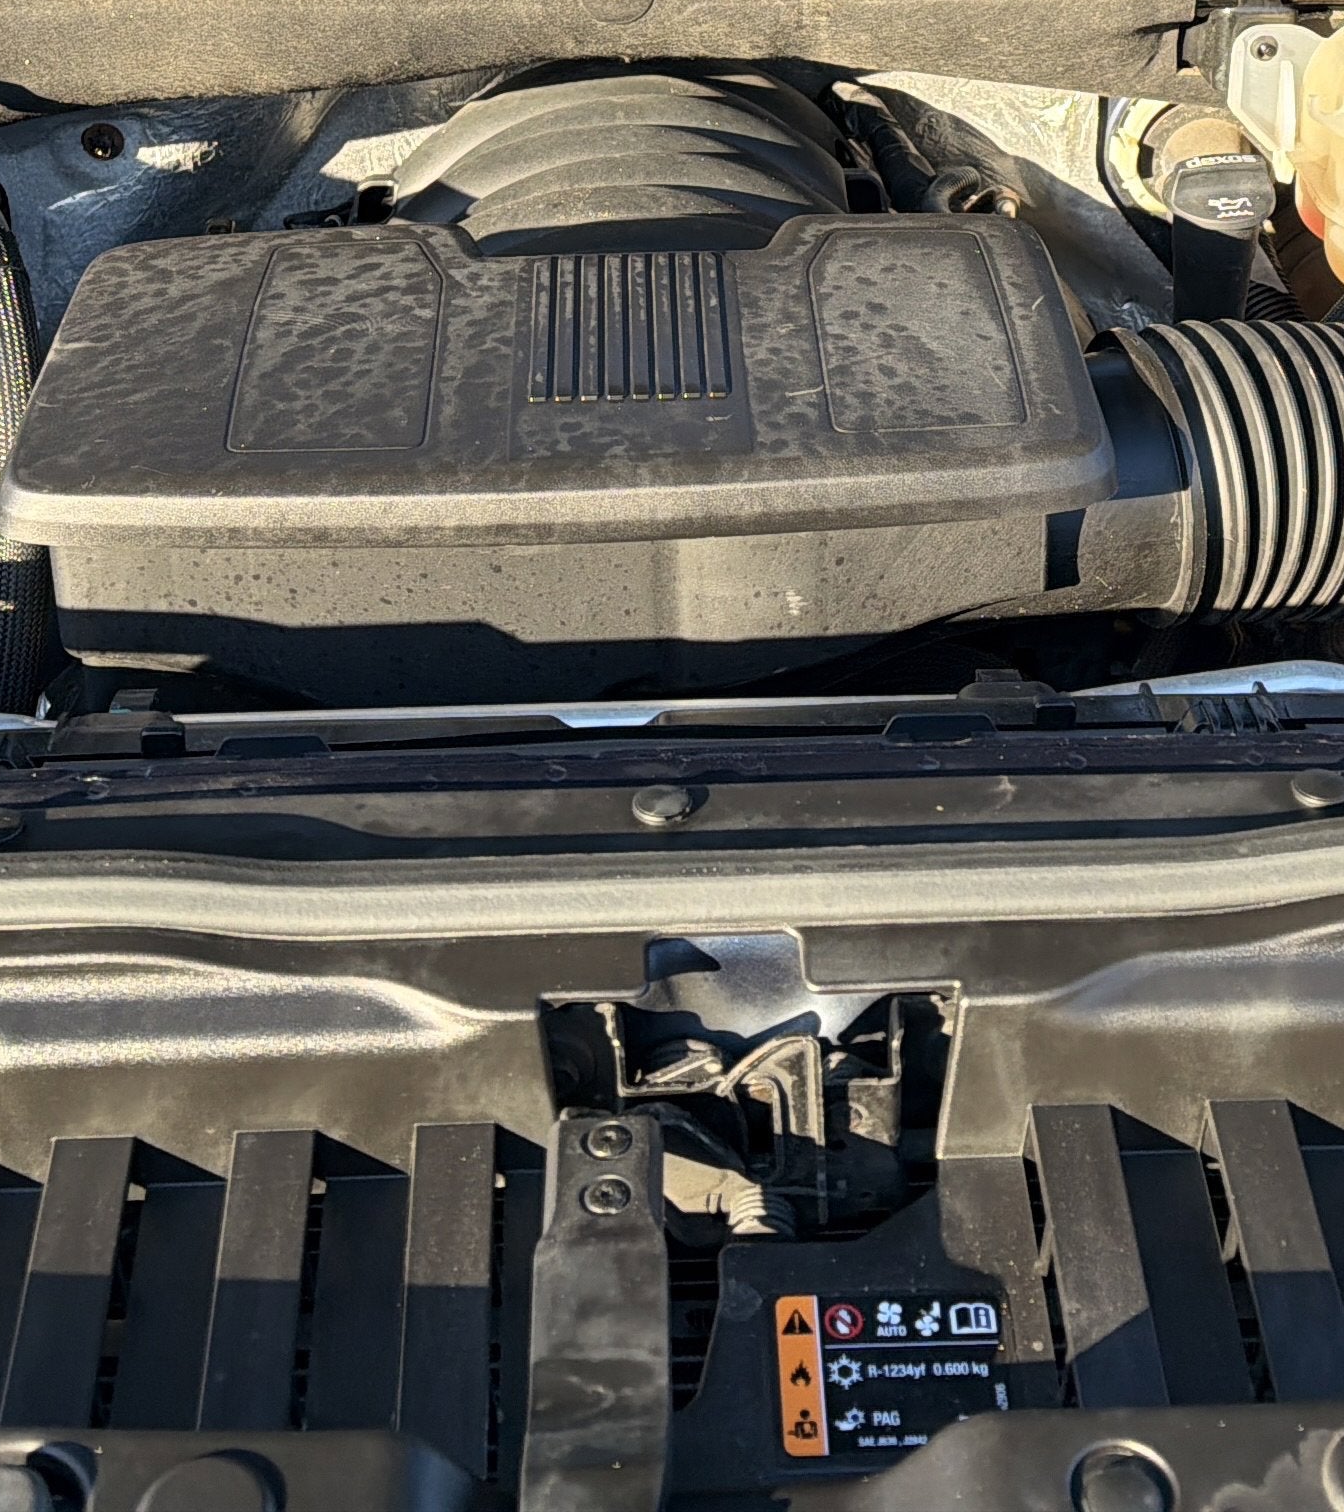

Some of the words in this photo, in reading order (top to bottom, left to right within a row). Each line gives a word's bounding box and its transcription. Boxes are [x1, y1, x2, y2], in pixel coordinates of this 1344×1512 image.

[1185, 154, 1257, 169] dexos
[877, 1325, 907, 1337] AUTO
[868, 1362, 926, 1379] R-1234yf
[971, 1361, 989, 1377] kg
[873, 1410, 901, 1426] PAG
